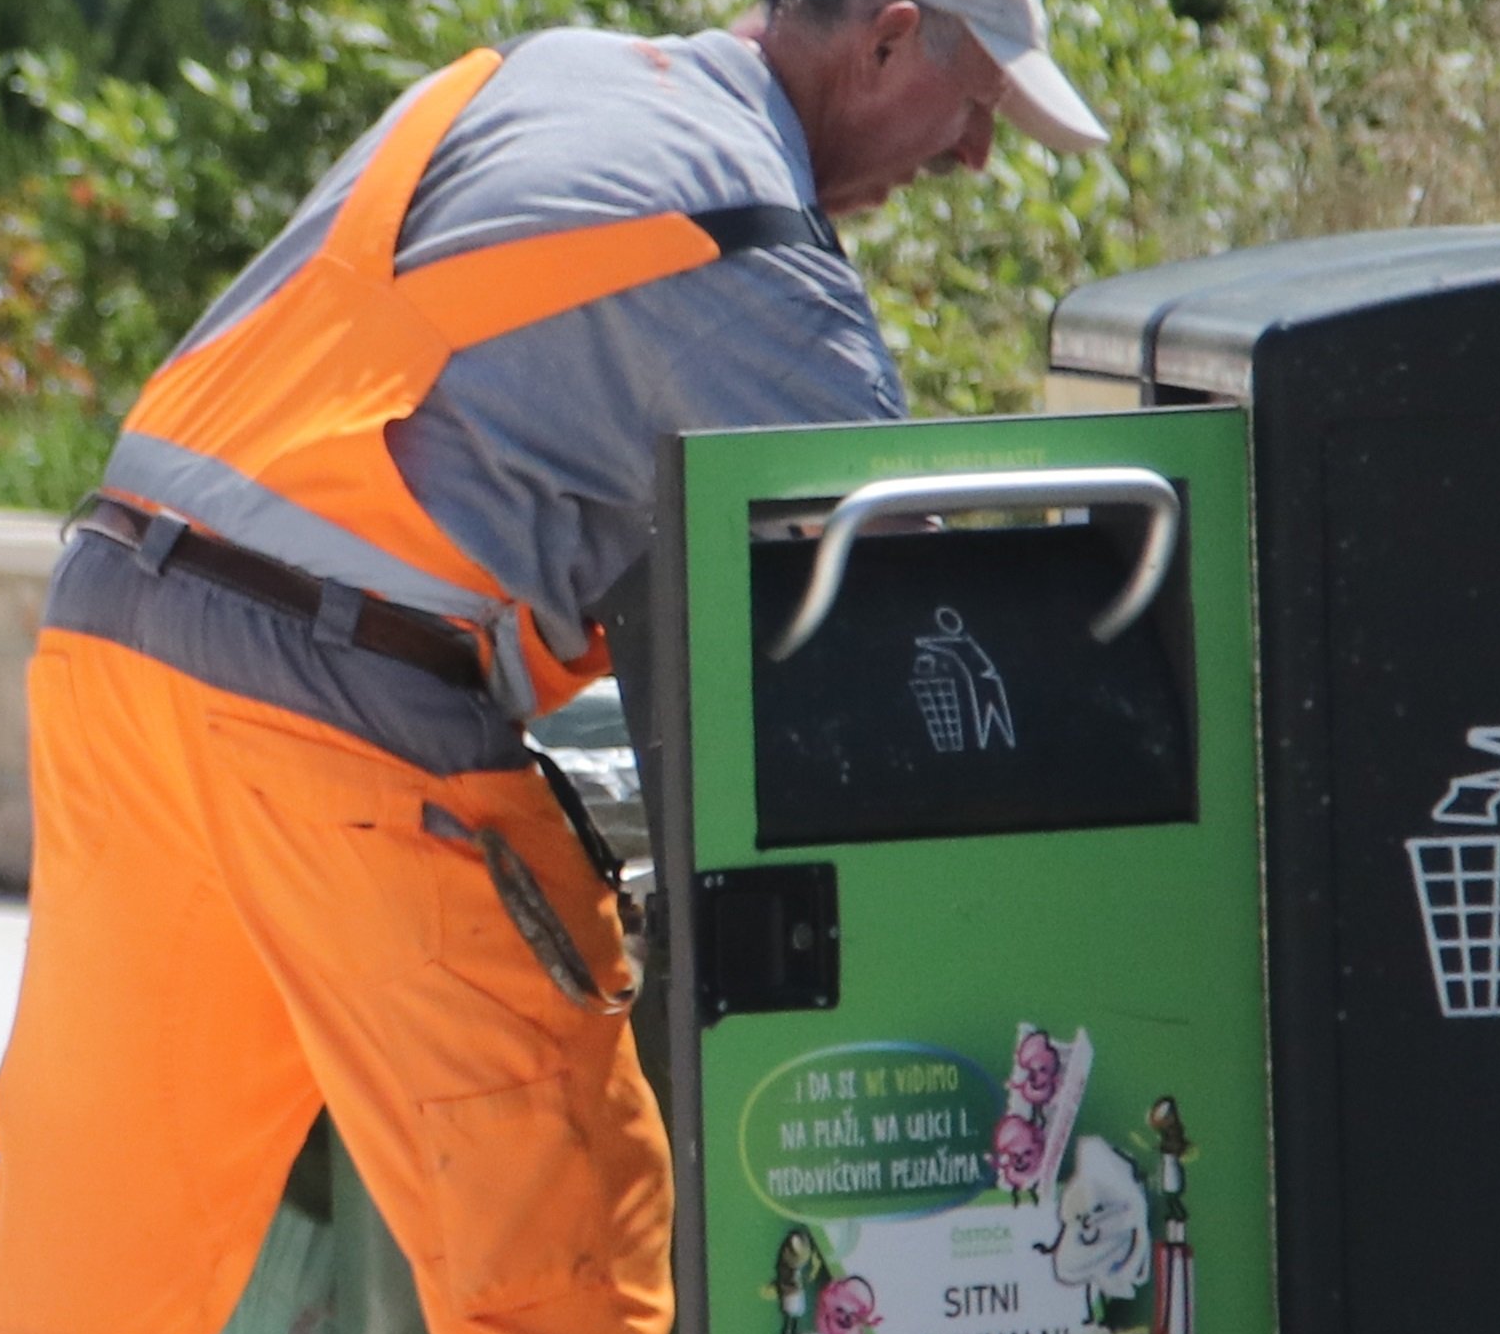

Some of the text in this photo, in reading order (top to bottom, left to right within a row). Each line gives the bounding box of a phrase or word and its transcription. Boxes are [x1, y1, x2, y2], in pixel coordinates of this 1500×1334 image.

[807, 1070, 832, 1101] DA
[779, 1118, 806, 1151] NA
[944, 1281, 1020, 1319] SITNI
